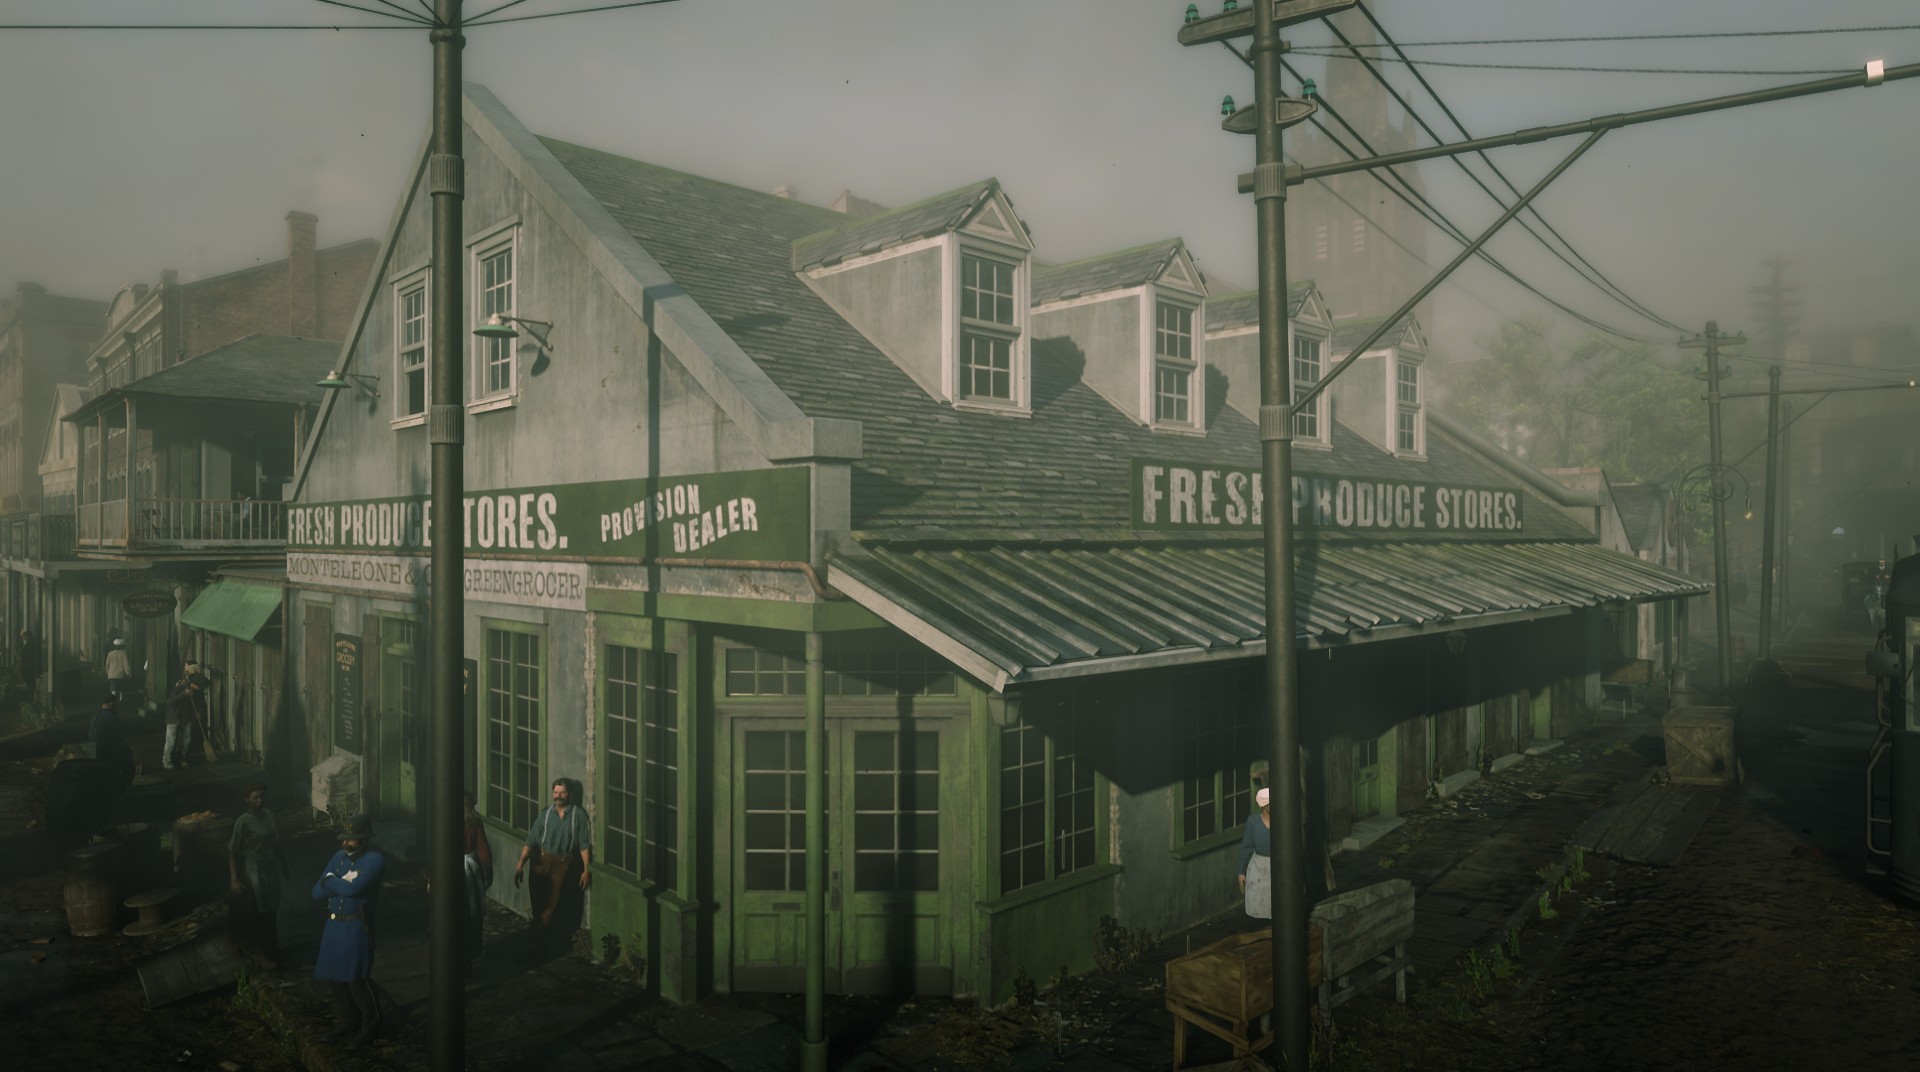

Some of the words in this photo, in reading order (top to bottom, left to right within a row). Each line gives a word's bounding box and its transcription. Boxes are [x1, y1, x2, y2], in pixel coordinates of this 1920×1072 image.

[288, 506, 335, 546] FRESH
[341, 500, 432, 548] PRODUCE
[463, 492, 568, 550] TORES.
[601, 484, 700, 542] PROVISION
[673, 497, 758, 553] DEALER
[1291, 476, 1426, 529] PRODUCE
[1435, 487, 1522, 530] STORES.
[289, 557, 401, 584] MONTELEONE
[404, 562, 418, 586] &
[464, 569, 582, 600] GREENGROCER
